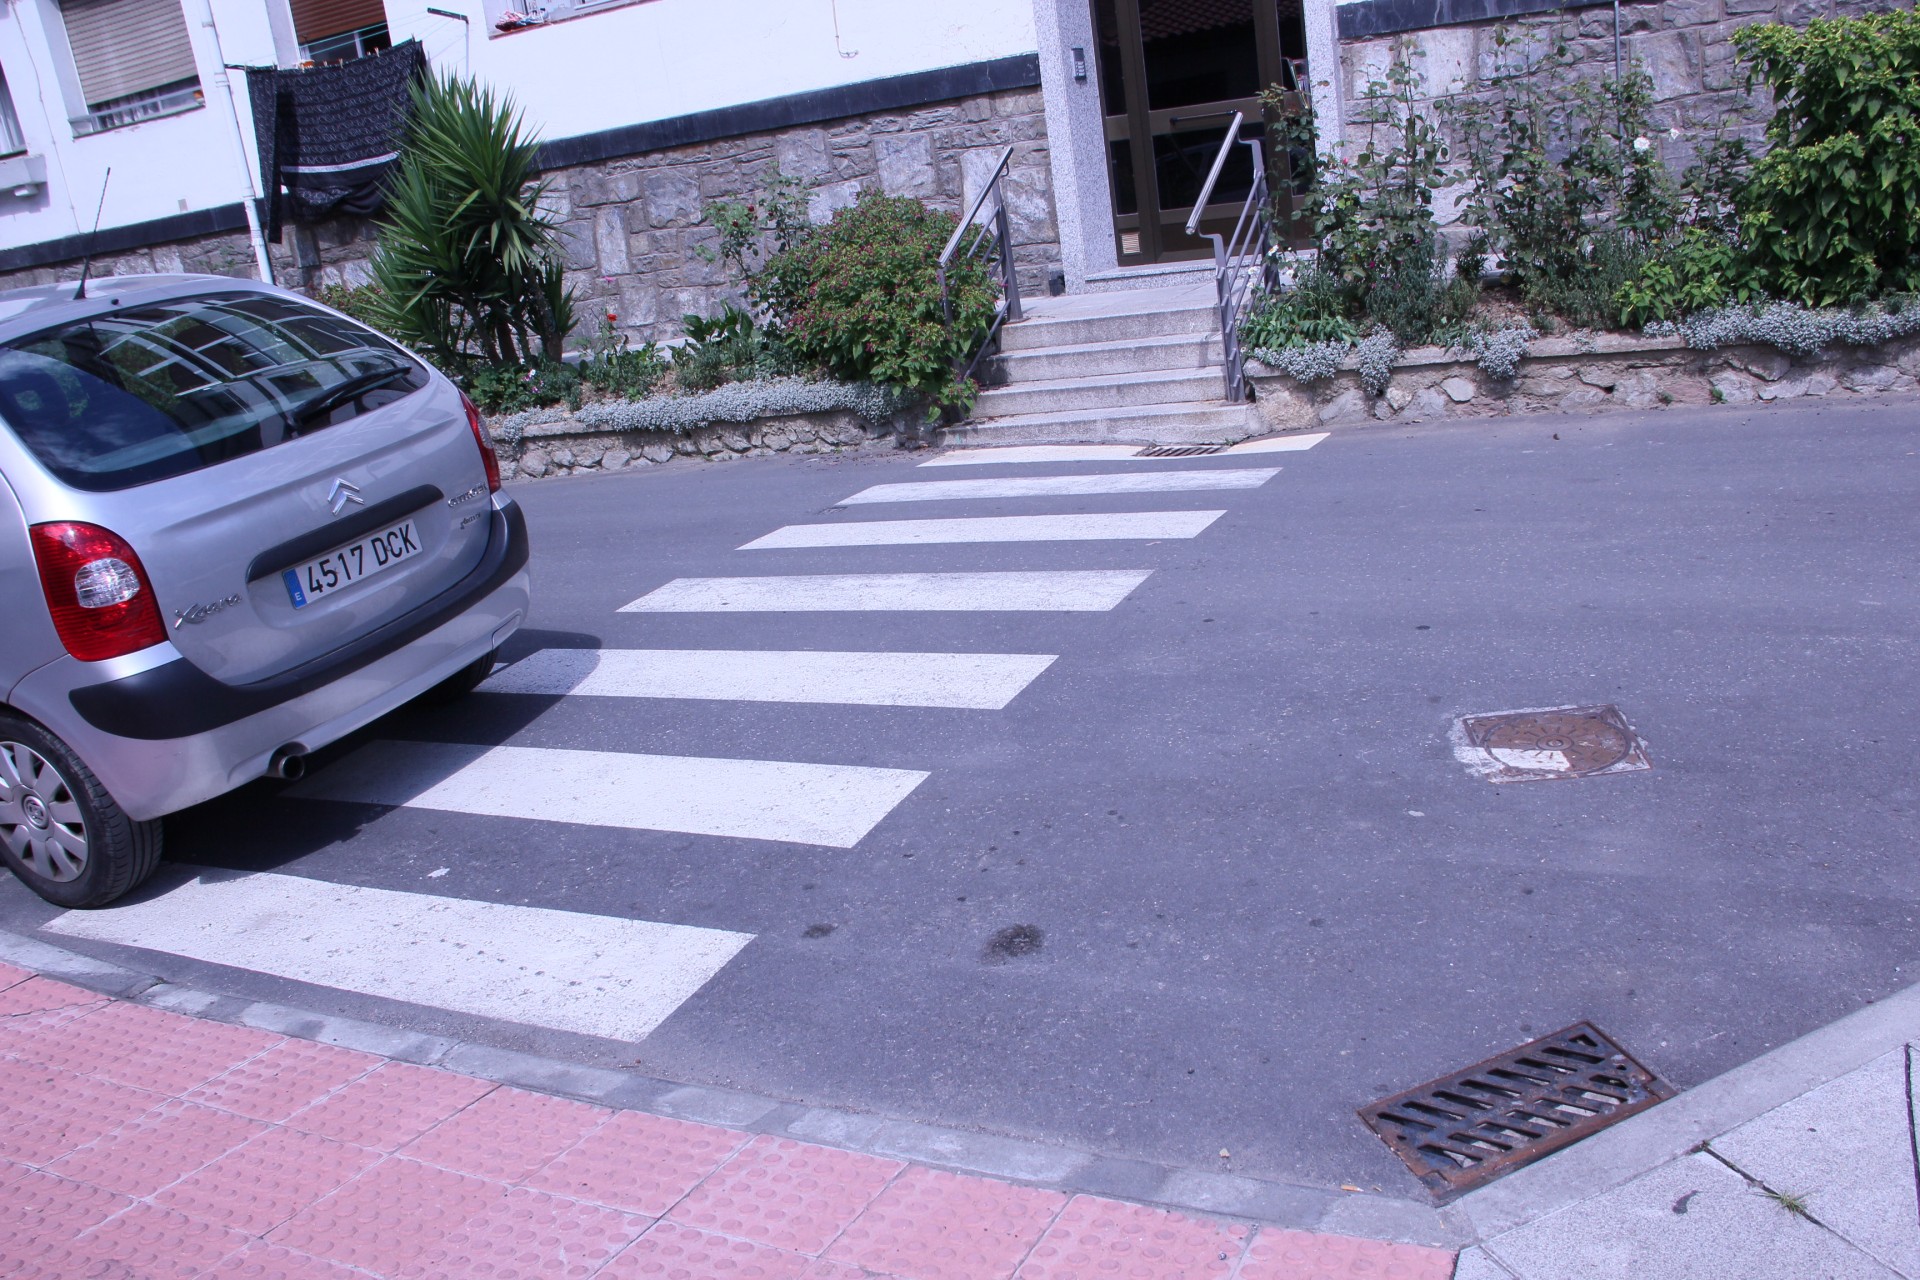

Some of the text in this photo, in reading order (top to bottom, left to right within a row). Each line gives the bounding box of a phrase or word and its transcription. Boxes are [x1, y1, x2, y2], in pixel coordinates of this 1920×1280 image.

[294, 523, 417, 601] E 4517 DCK
